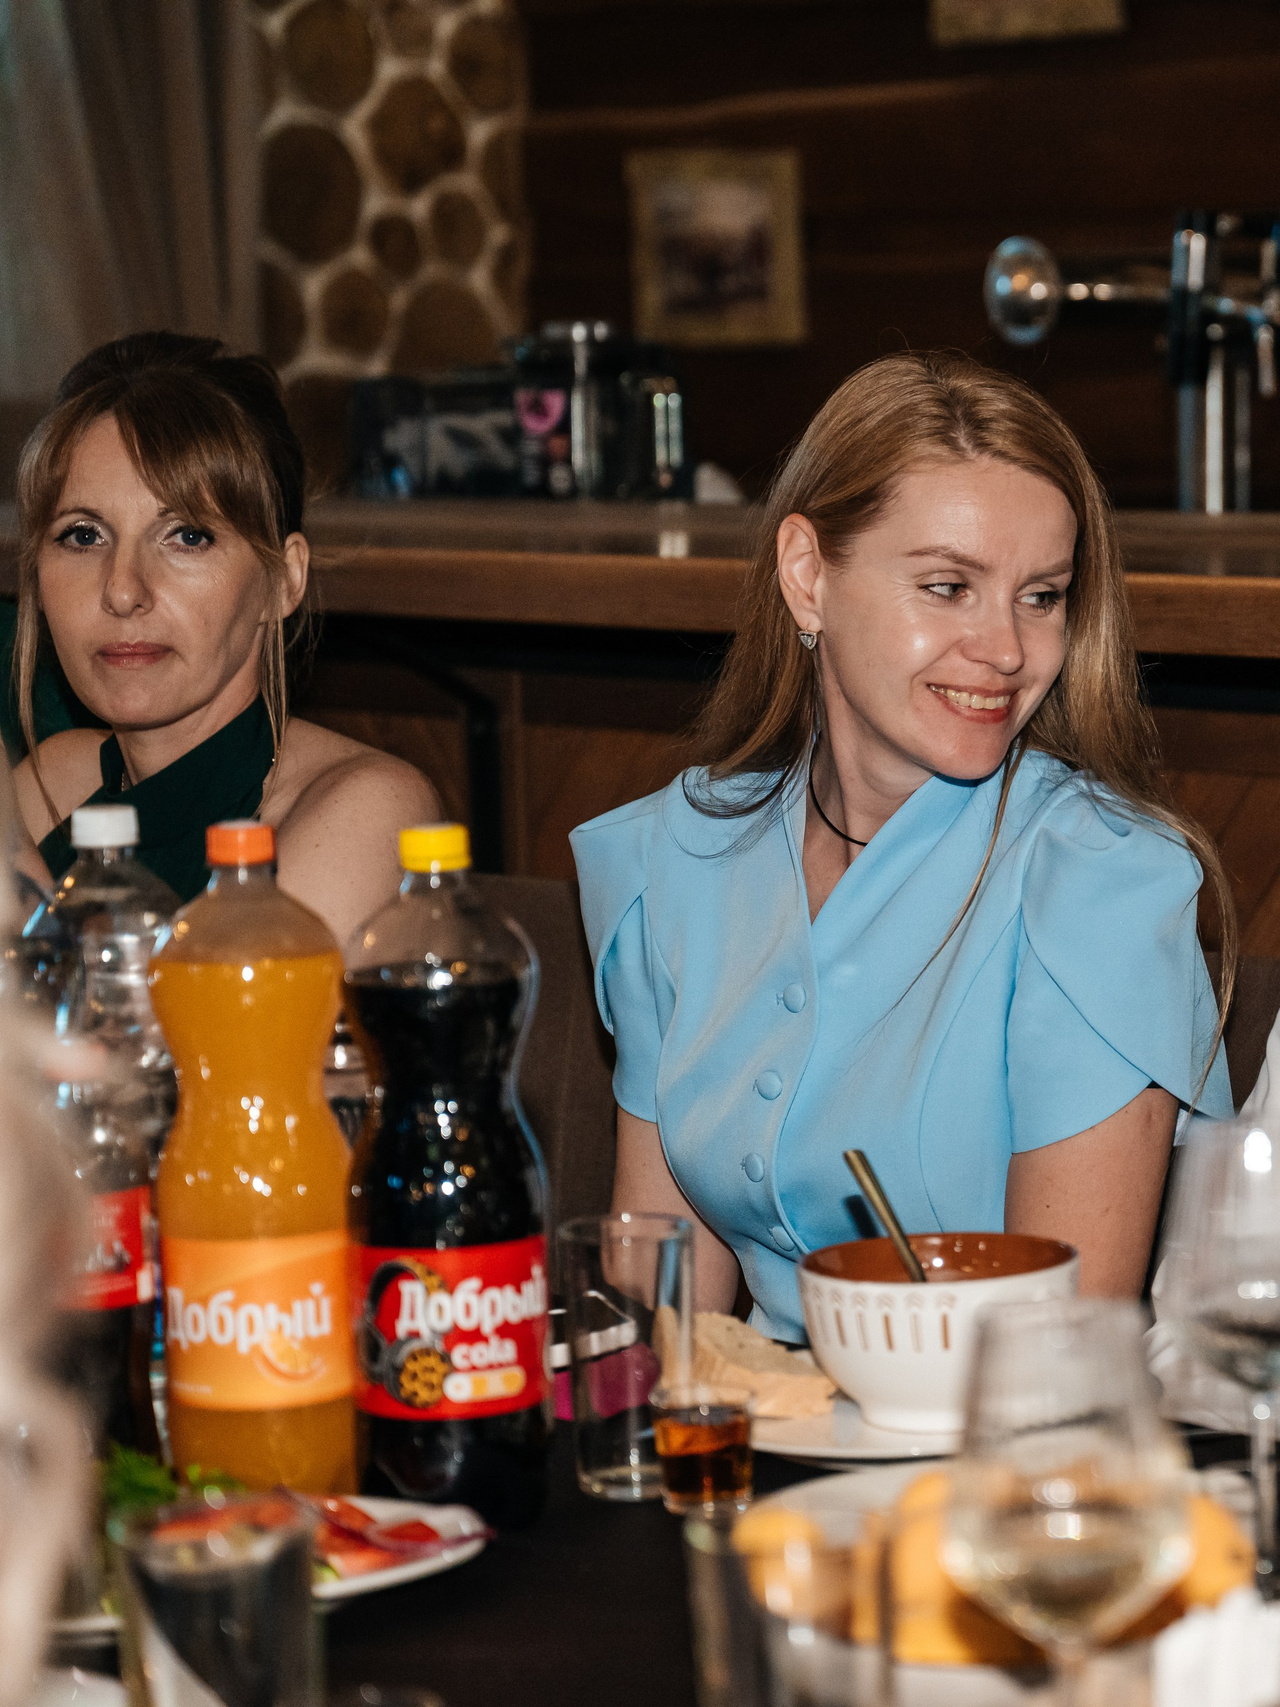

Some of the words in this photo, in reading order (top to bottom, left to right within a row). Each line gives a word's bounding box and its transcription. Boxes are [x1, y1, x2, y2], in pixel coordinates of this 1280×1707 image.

[167, 1281, 332, 1355] Добрый
[395, 1262, 547, 1342] Добрый
[450, 1335, 518, 1370] cola
